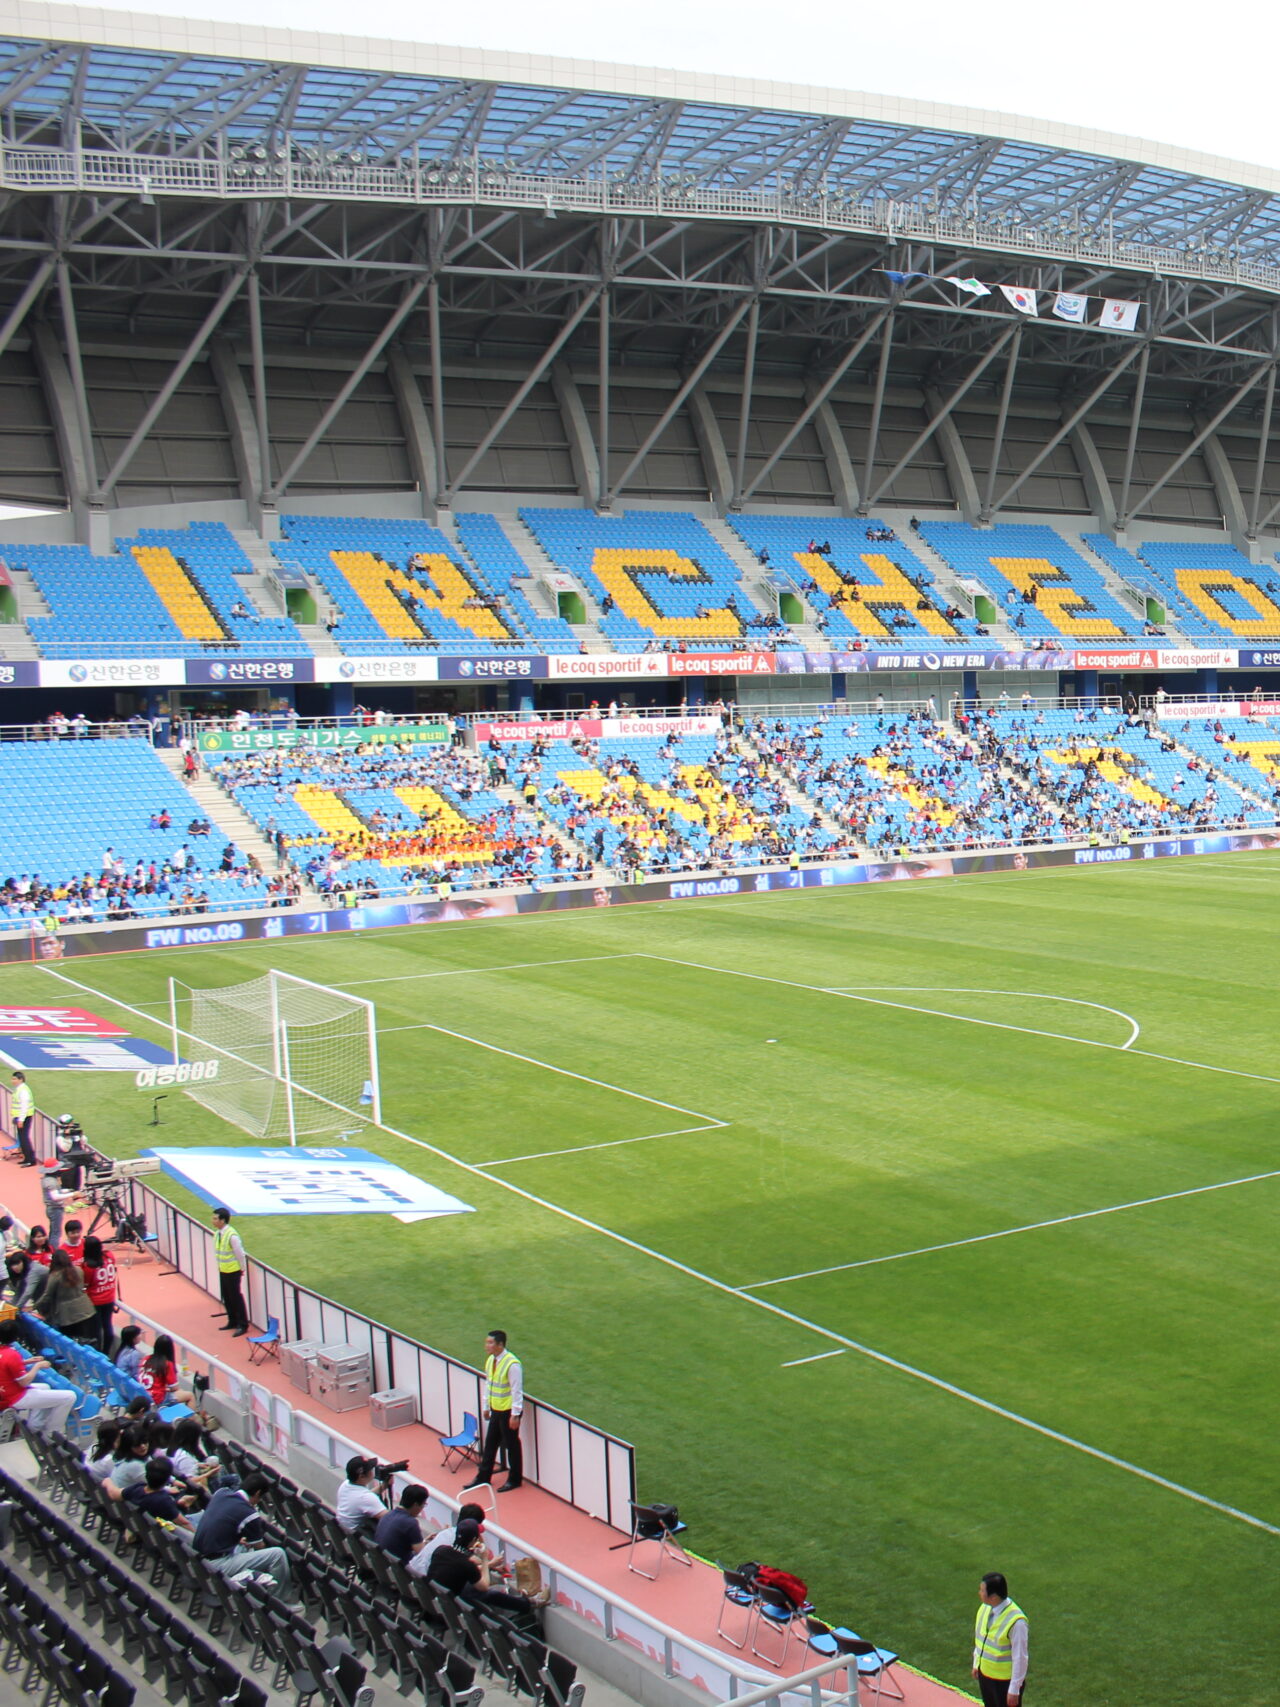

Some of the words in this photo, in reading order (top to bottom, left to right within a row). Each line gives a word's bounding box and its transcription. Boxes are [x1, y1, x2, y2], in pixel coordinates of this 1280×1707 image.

[474, 659, 531, 675] 신한은행
[556, 659, 568, 674] le
[571, 661, 596, 676] coq
[598, 658, 642, 675] sportif
[672, 657, 684, 671] le
[685, 659, 709, 675] coq
[711, 655, 753, 674] sportif
[877, 655, 900, 668] INTO
[902, 655, 920, 668] THE
[943, 655, 964, 667] NEW
[966, 655, 985, 667] ERA
[1077, 654, 1087, 666] le
[1088, 655, 1107, 669] coq
[1108, 652, 1141, 668] sportif
[1162, 653, 1170, 665] le
[1171, 655, 1190, 667] coq
[1191, 652, 1221, 667] sportif
[90, 664, 160, 681] 신한은행
[228, 663, 293, 680] 신한은행
[357, 661, 416, 677] 신한은행
[1164, 706, 1171, 715] le
[1172, 707, 1188, 716] coq
[1190, 705, 1216, 715] sportif
[1251, 704, 1258, 713] le
[1259, 706, 1275, 714] coq
[504, 726, 526, 740] coq
[526, 722, 567, 739] sportif
[620, 721, 630, 733] le
[632, 723, 654, 735] coq
[655, 720, 692, 733] sportif
[1075, 850, 1094, 864] FW
[1096, 847, 1131, 861] NO.09
[670, 882, 695, 898] FW
[697, 877, 739, 896] NO.09
[147, 926, 179, 948] FW
[185, 922, 244, 943] NO.09
[309, 912, 327, 932] 기
[136, 1060, 219, 1087] 여명808
[97, 1263, 115, 1286] 99
